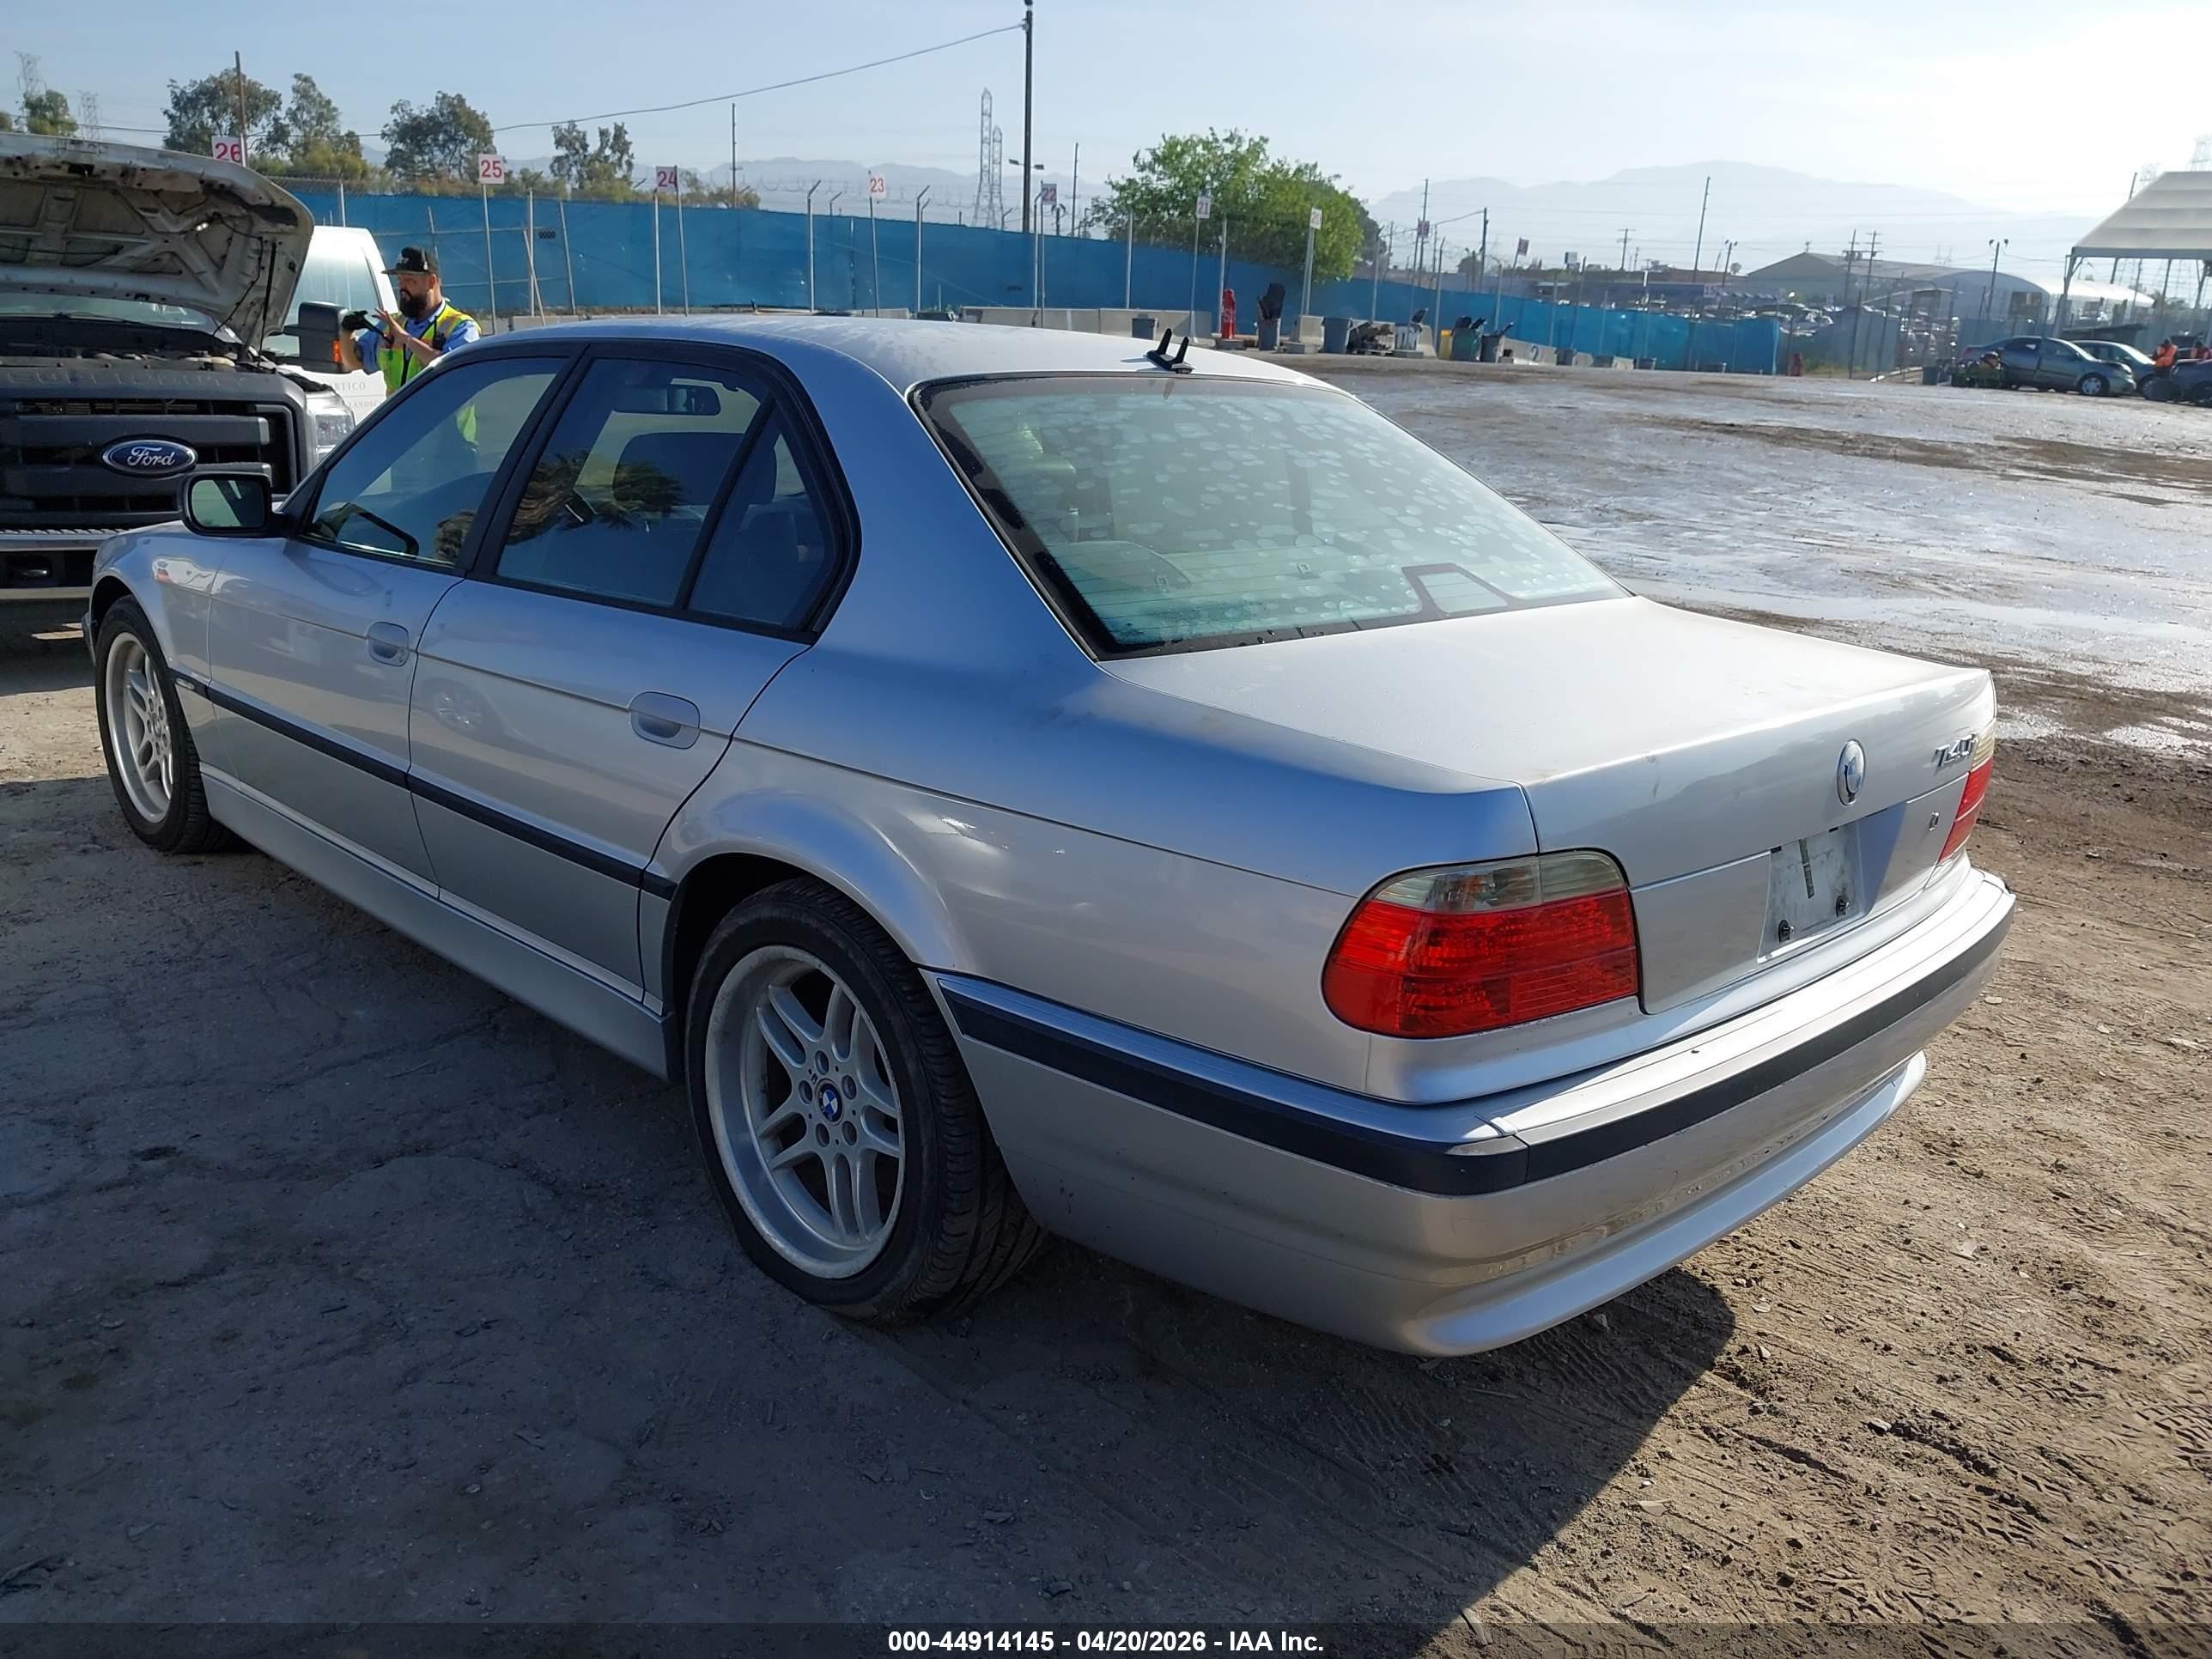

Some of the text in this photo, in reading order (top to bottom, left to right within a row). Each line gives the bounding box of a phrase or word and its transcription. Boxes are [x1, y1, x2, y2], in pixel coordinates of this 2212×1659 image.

[215, 143, 241, 163] 26
[481, 159, 502, 179] 25
[658, 171, 678, 187] 24
[869, 178, 884, 193] 23
[127, 447, 175, 466] Ford
